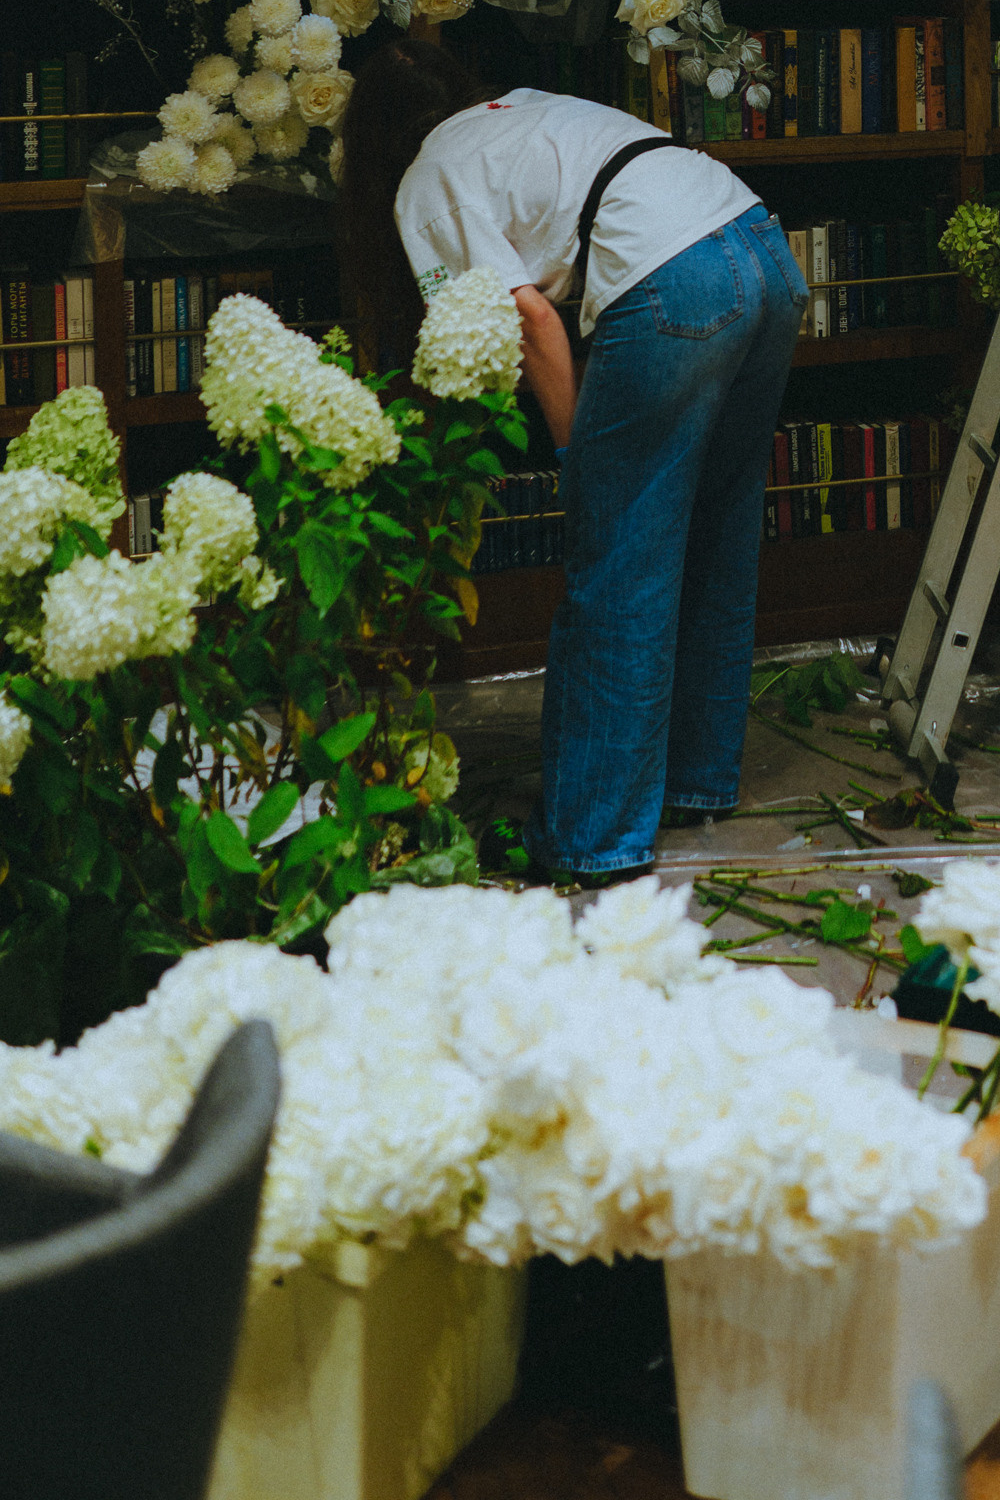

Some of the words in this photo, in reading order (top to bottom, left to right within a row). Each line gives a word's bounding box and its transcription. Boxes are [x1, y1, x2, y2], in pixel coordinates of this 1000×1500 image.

[870, 58, 878, 85] МАРК
[9, 282, 17, 310] МОРЯ
[19, 282, 27, 328] ГИГАНТЫ
[10, 312, 18, 338] ГОРЫ
[839, 311, 848, 333] ЕЛЕНА
